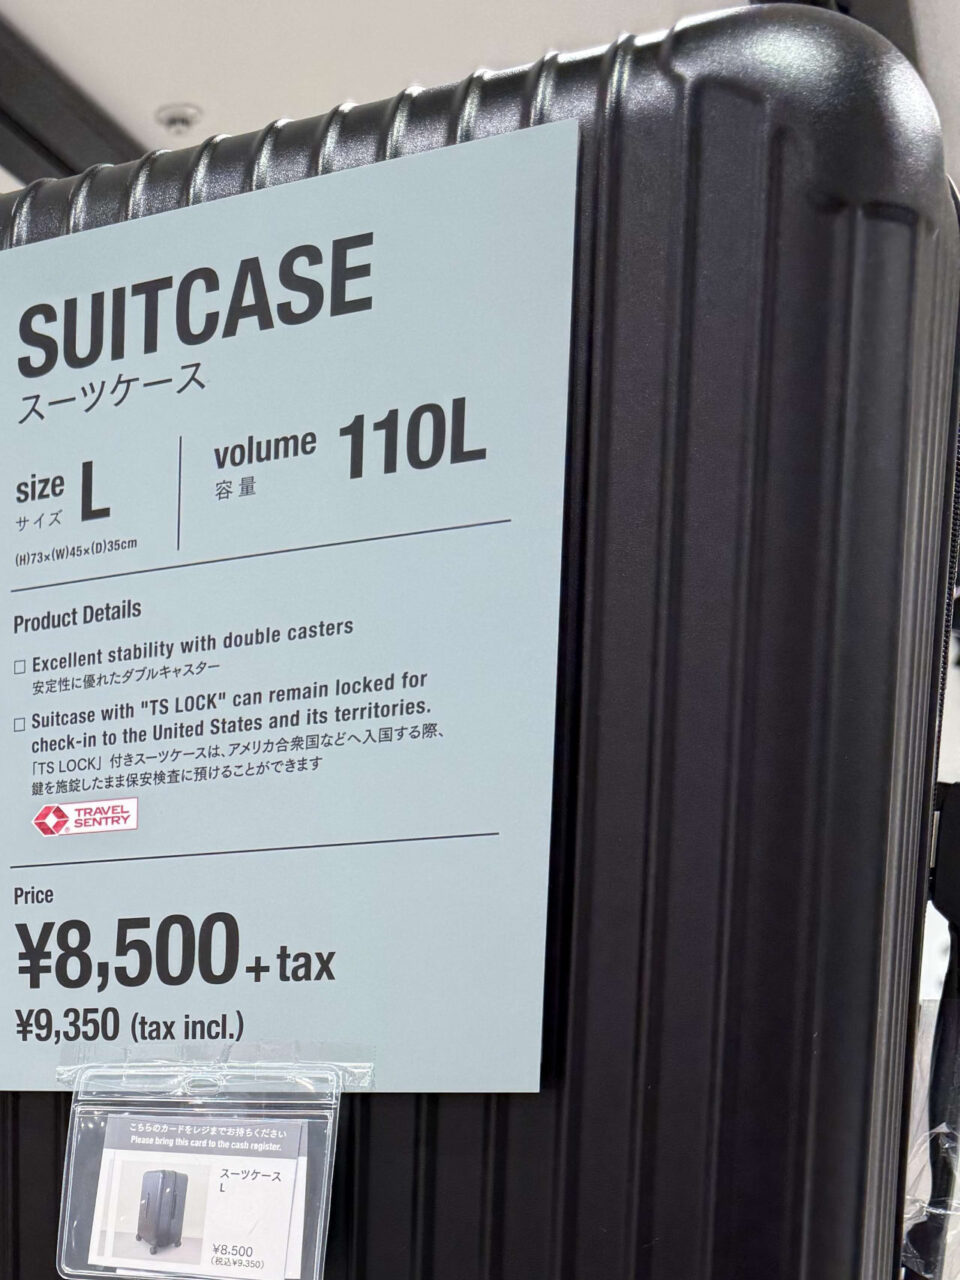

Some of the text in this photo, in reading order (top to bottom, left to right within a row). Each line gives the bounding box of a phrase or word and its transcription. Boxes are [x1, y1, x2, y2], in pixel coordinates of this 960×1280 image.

[17, 232, 374, 379] SUITCASE
[17, 362, 207, 424] スーツケース
[214, 396, 487, 479] volume 110L
[15, 460, 111, 521] size L
[215, 476, 257, 501] 容量
[15, 509, 63, 532] サイズ
[13, 599, 142, 634] Product Details
[31, 619, 354, 673] Excellent stability with double casters
[32, 661, 220, 696] 安定性に優れたダブルキャスター
[31, 670, 428, 731] Suitcase with "TS LOCK" can remain locked for
[31, 699, 431, 754] check-in to the United States and its territories.
[74, 805, 130, 818] TRAVEL
[74, 815, 130, 828] SENTRY
[14, 886, 54, 905] Price
[14, 912, 240, 993] ¥8,500
[15, 1007, 244, 1045] ¥9,350 (tax incl.)
[129, 1123, 287, 1138] こちらのカードをレジまでお持ちください
[130, 1135, 154, 1145] Please
[155, 1137, 174, 1147] bring
[175, 1137, 189, 1146] this
[190, 1138, 207, 1147] card
[208, 1139, 216, 1148] to
[217, 1140, 230, 1149] the
[231, 1141, 249, 1150] cash
[219, 1168, 282, 1182] スーツケース
[219, 1183, 226, 1193] L
